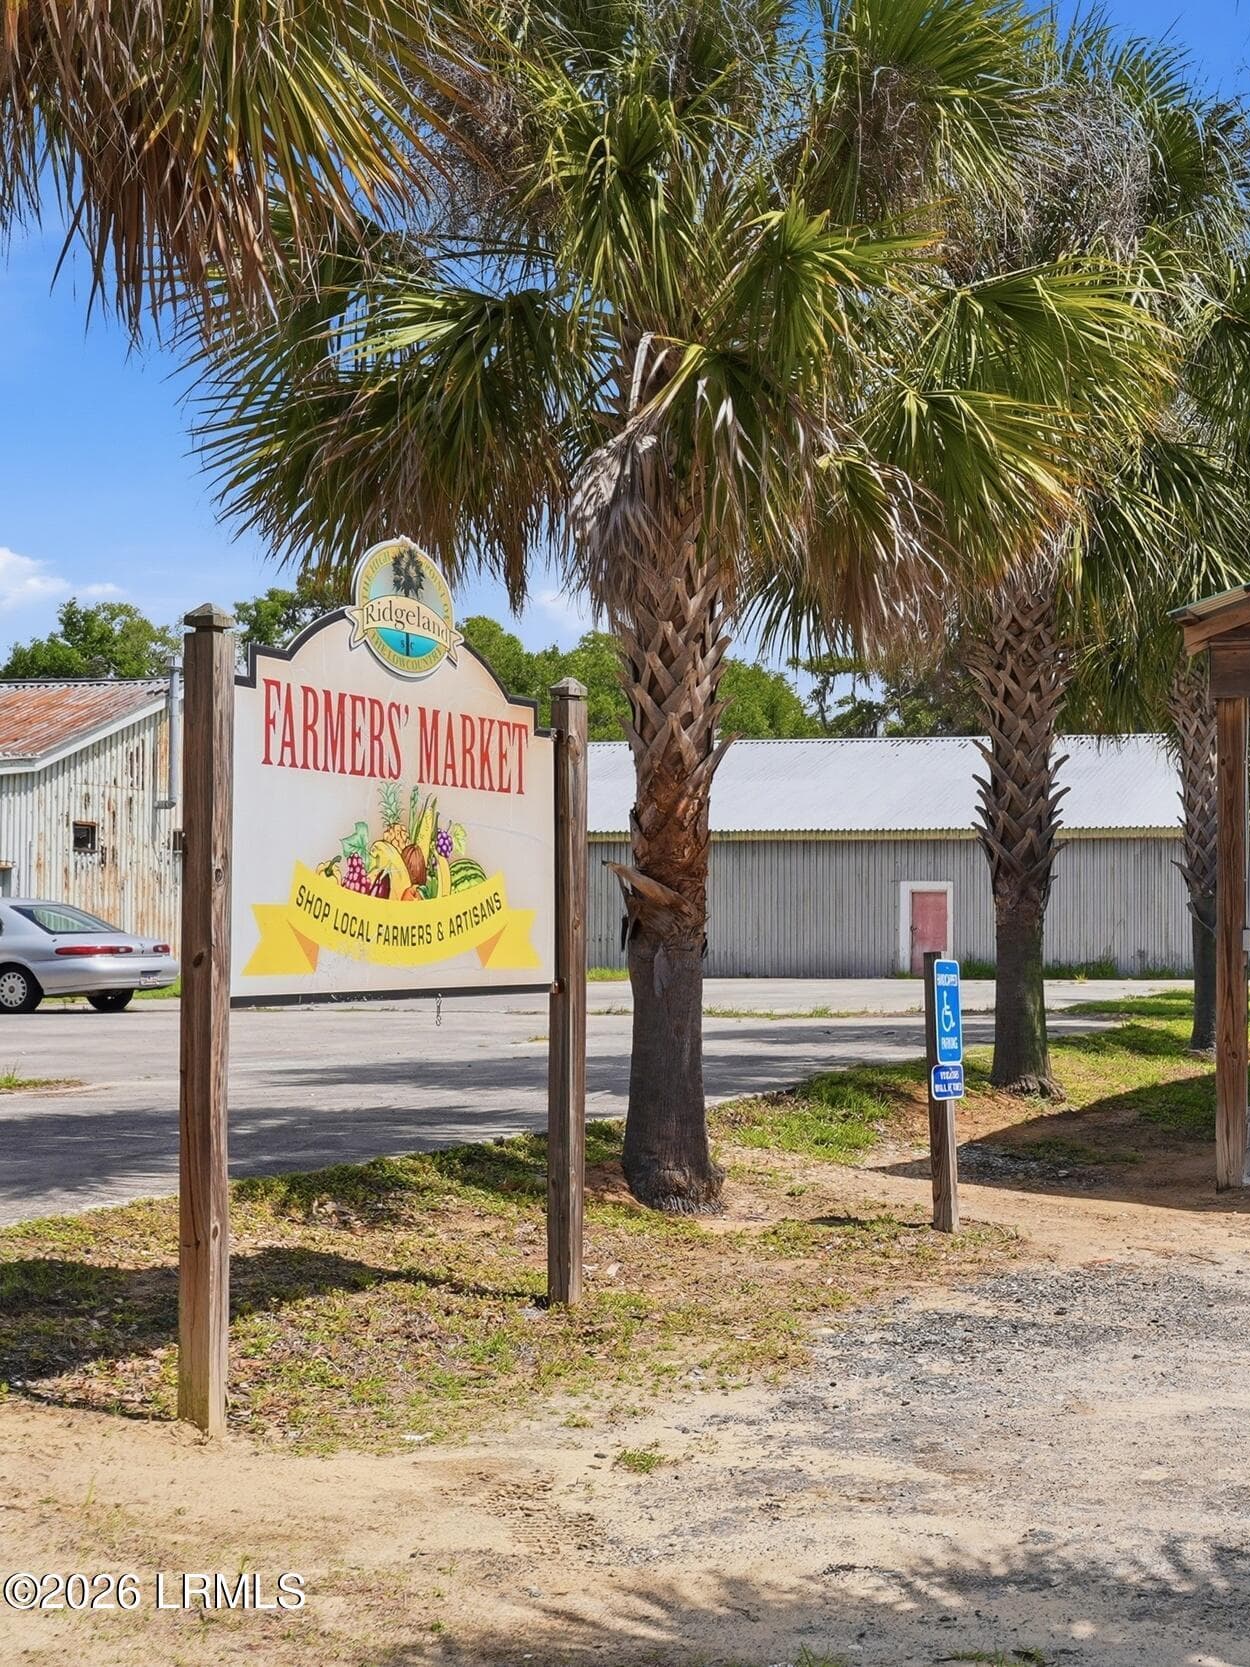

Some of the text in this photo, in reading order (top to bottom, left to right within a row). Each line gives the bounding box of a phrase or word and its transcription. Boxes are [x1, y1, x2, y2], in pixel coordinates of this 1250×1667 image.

[365, 599, 449, 644] Ridgeland
[261, 678, 528, 795] FARMERS' MARKET
[295, 884, 502, 947] SHOP LOCAL FARMERS & ARTISANS
